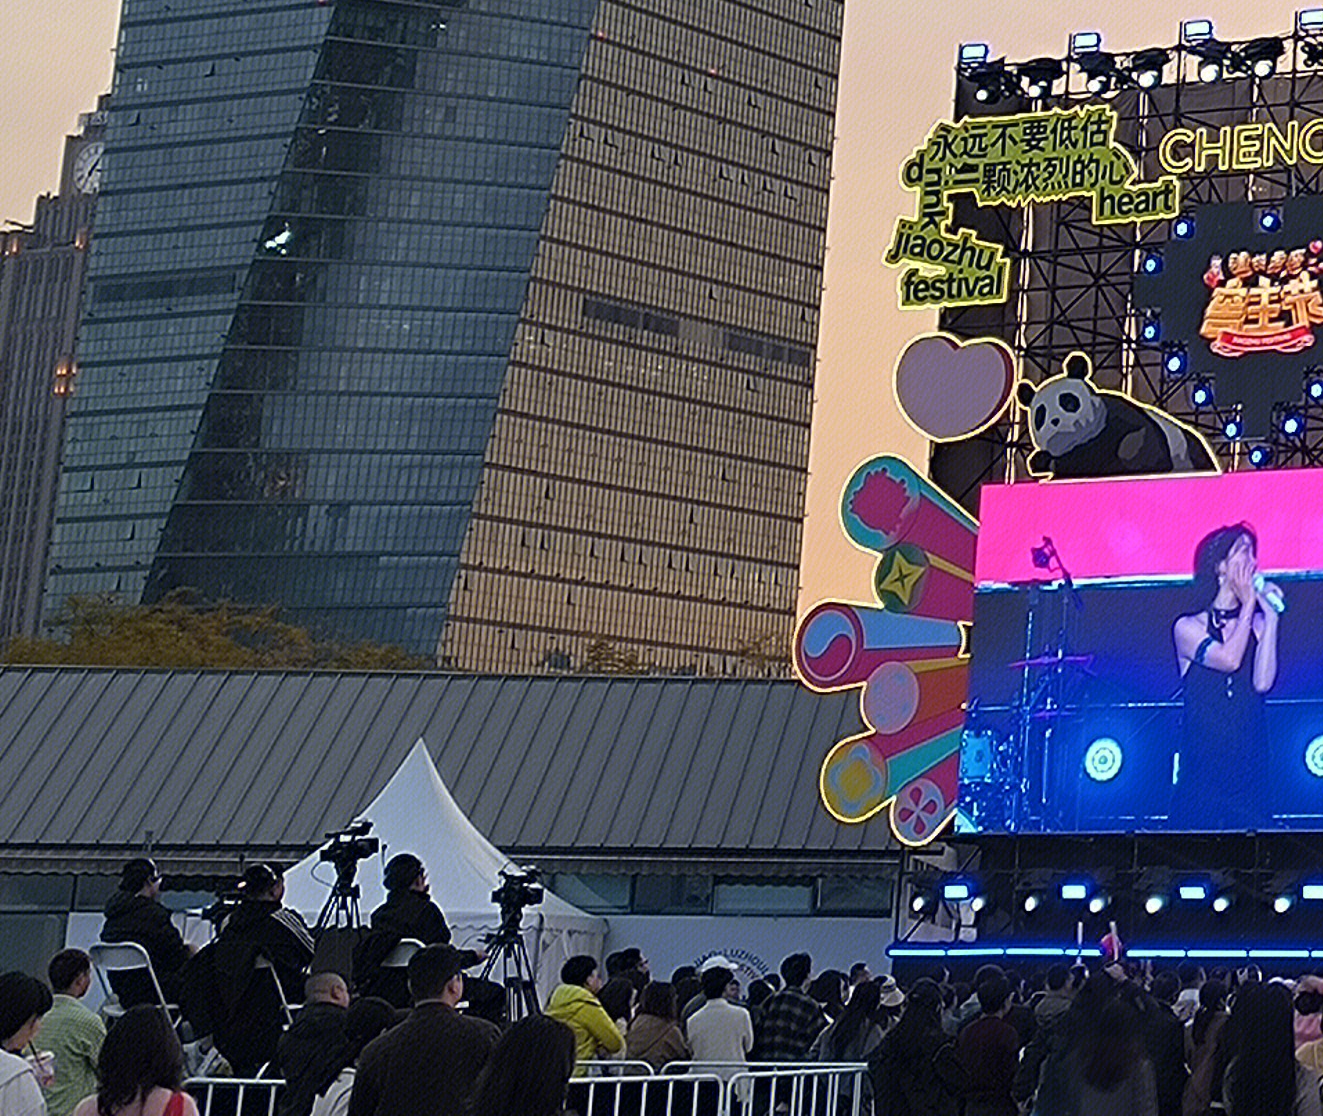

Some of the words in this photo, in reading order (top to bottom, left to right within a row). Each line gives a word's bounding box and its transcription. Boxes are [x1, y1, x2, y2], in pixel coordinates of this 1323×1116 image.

[930, 114, 1110, 163] 永远不要低估
[952, 152, 1129, 198] 一颗浓烈的心
[1100, 186, 1173, 217] heart
[889, 221, 995, 272] jiaozhu
[904, 266, 1003, 302] festival
